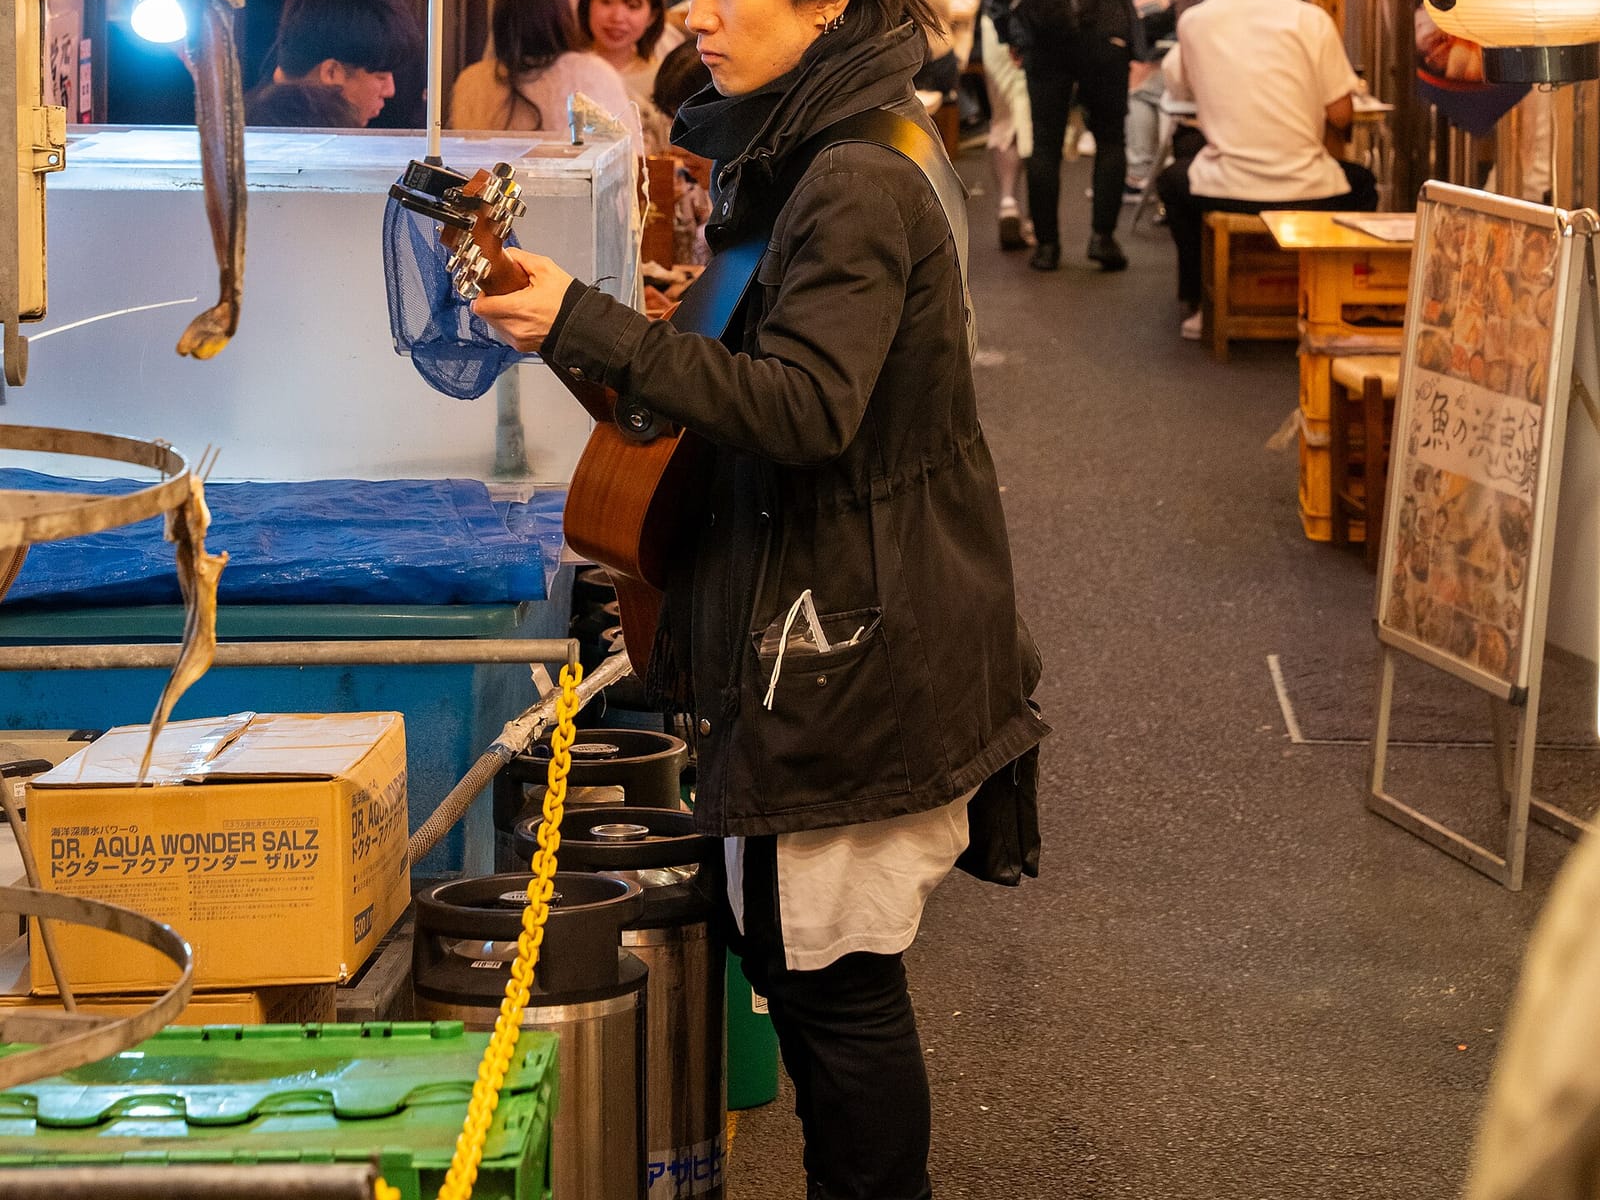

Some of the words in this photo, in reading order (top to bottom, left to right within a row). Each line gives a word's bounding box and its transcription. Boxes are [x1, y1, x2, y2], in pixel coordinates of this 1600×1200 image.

[51, 825, 138, 837] 海洋深層水パワーの
[351, 808, 366, 839] DR.
[51, 838, 85, 860] DR.
[93, 834, 155, 858] AQUA
[161, 831, 256, 855] WONDER
[262, 829, 319, 852] SALZ
[51, 857, 175, 878] ドクターアクア
[184, 854, 258, 873] ワンダー
[264, 852, 319, 870] ザルツ
